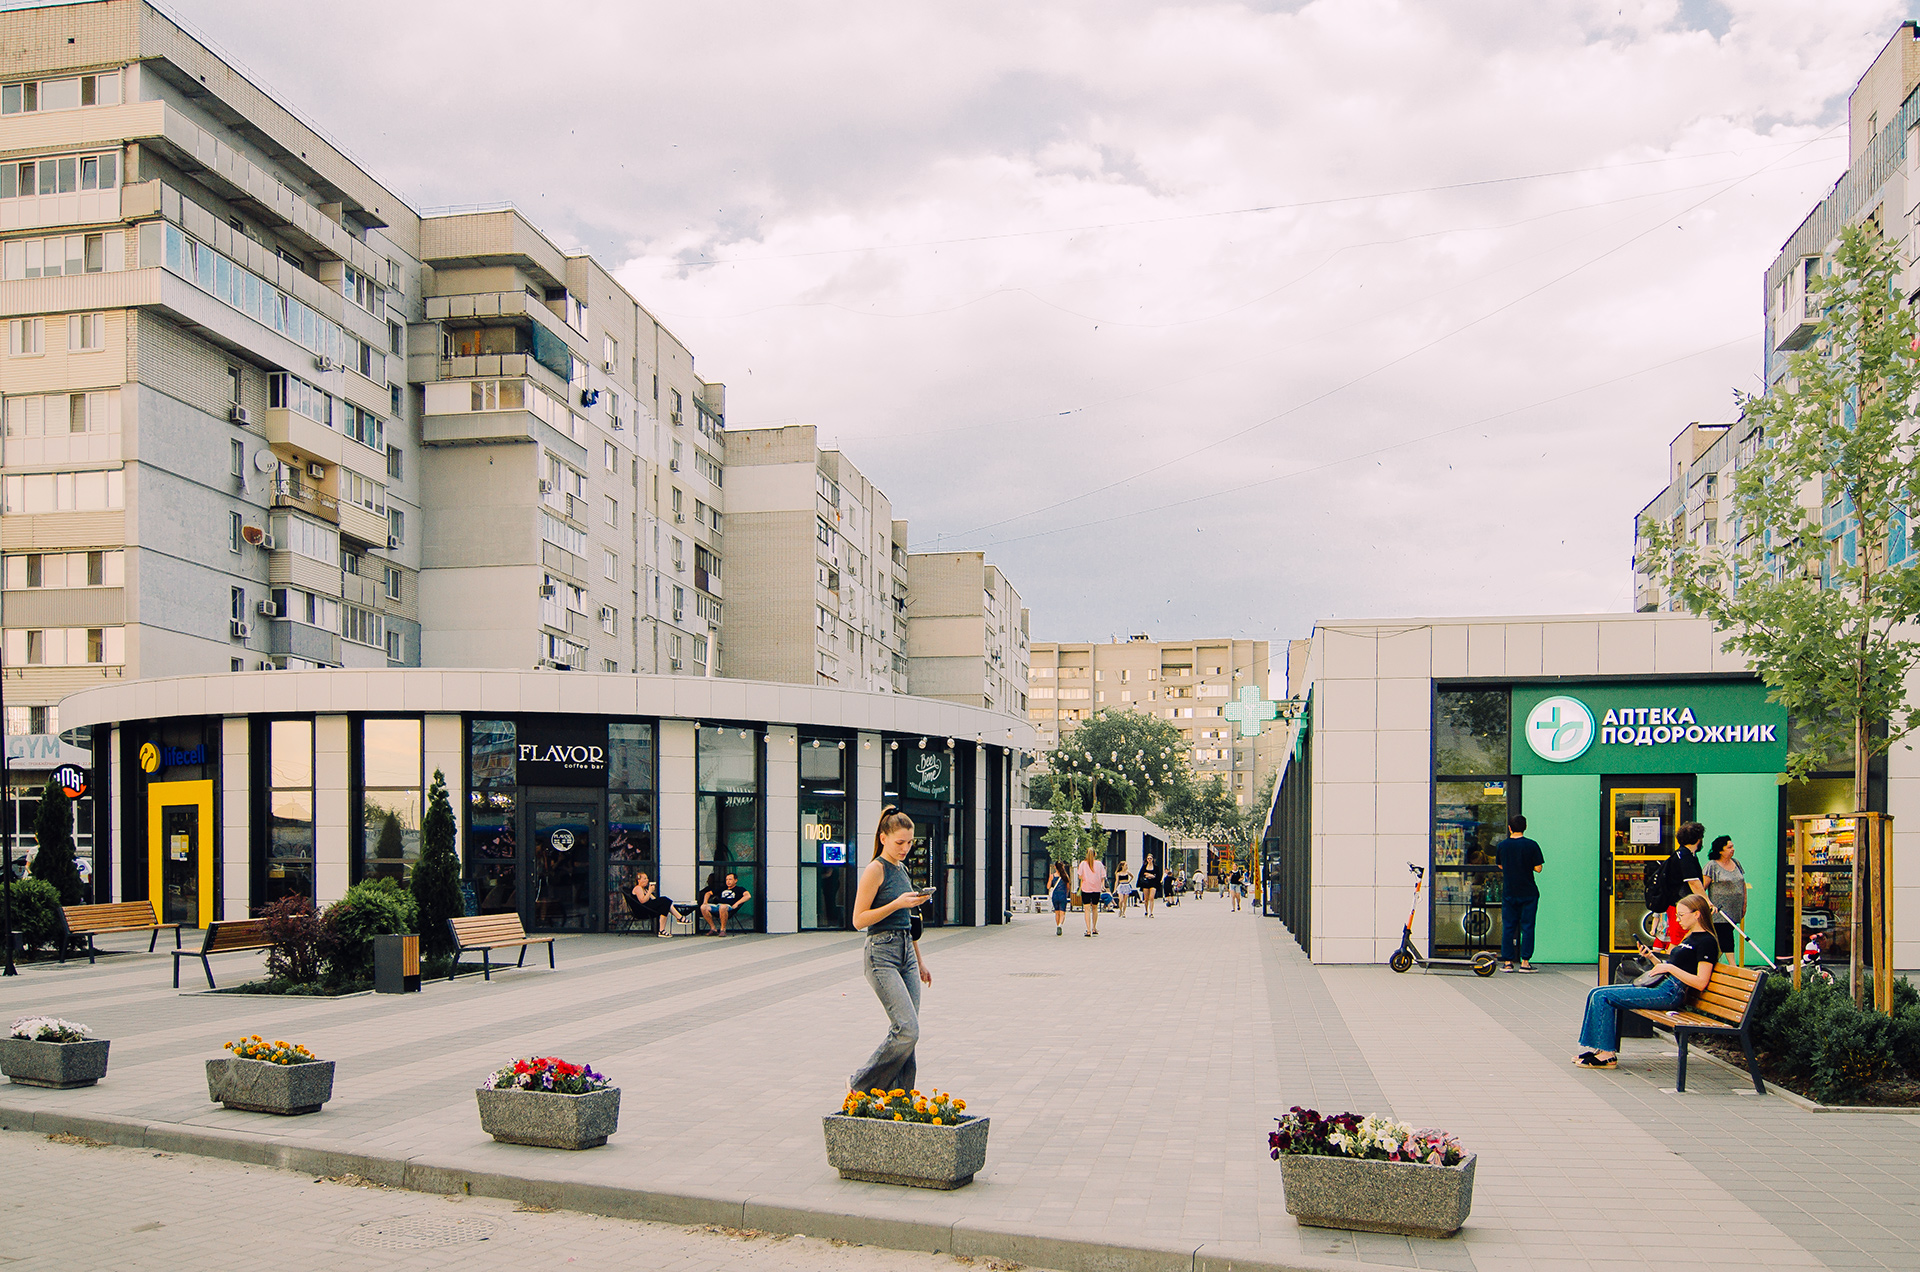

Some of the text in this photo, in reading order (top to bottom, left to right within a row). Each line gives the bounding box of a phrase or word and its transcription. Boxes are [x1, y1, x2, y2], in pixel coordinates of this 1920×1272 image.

[1602, 707, 1696, 726] АПТЕКА
[1601, 725, 1776, 746] ПОДОРОЖНИК
[9, 736, 60, 759] GYM
[164, 744, 205, 766] lifecell
[519, 744, 604, 762] FLAVOR
[919, 753, 936, 770] Beer
[805, 823, 832, 841] ПИВО
